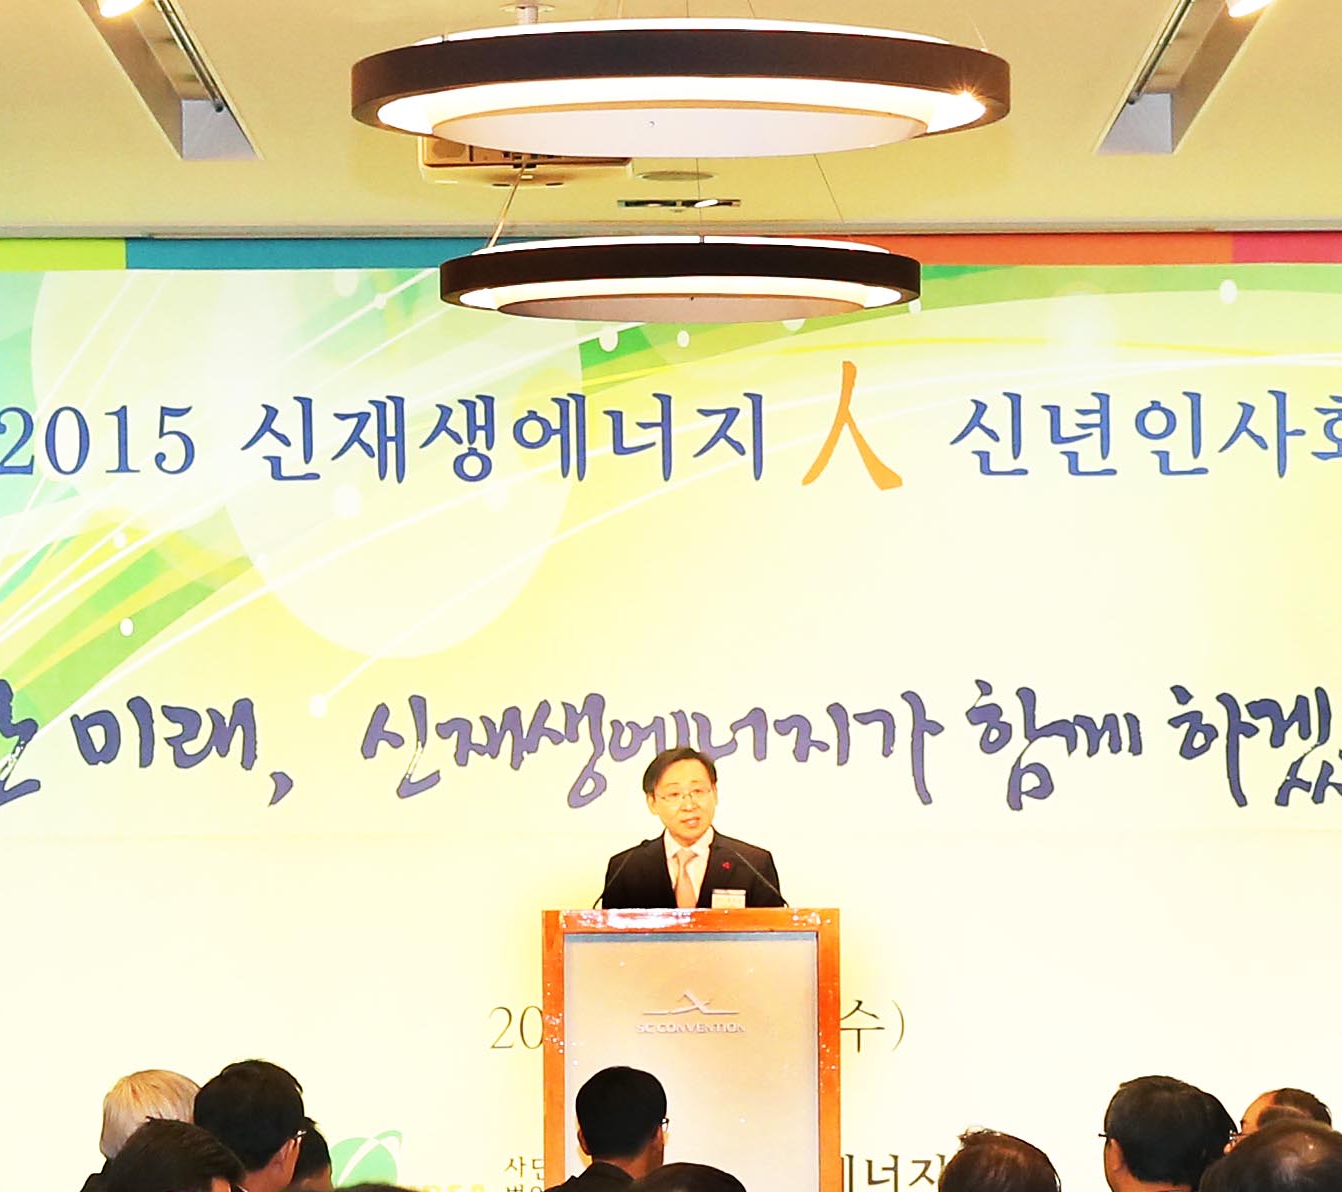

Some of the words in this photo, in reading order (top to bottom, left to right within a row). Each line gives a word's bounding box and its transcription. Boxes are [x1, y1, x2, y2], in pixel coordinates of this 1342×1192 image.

[240, 393, 764, 485] 신재생에너지
[70, 696, 295, 808] 미래,
[360, 690, 944, 810] 신재생에너지가
[966, 679, 1143, 811] 함께
